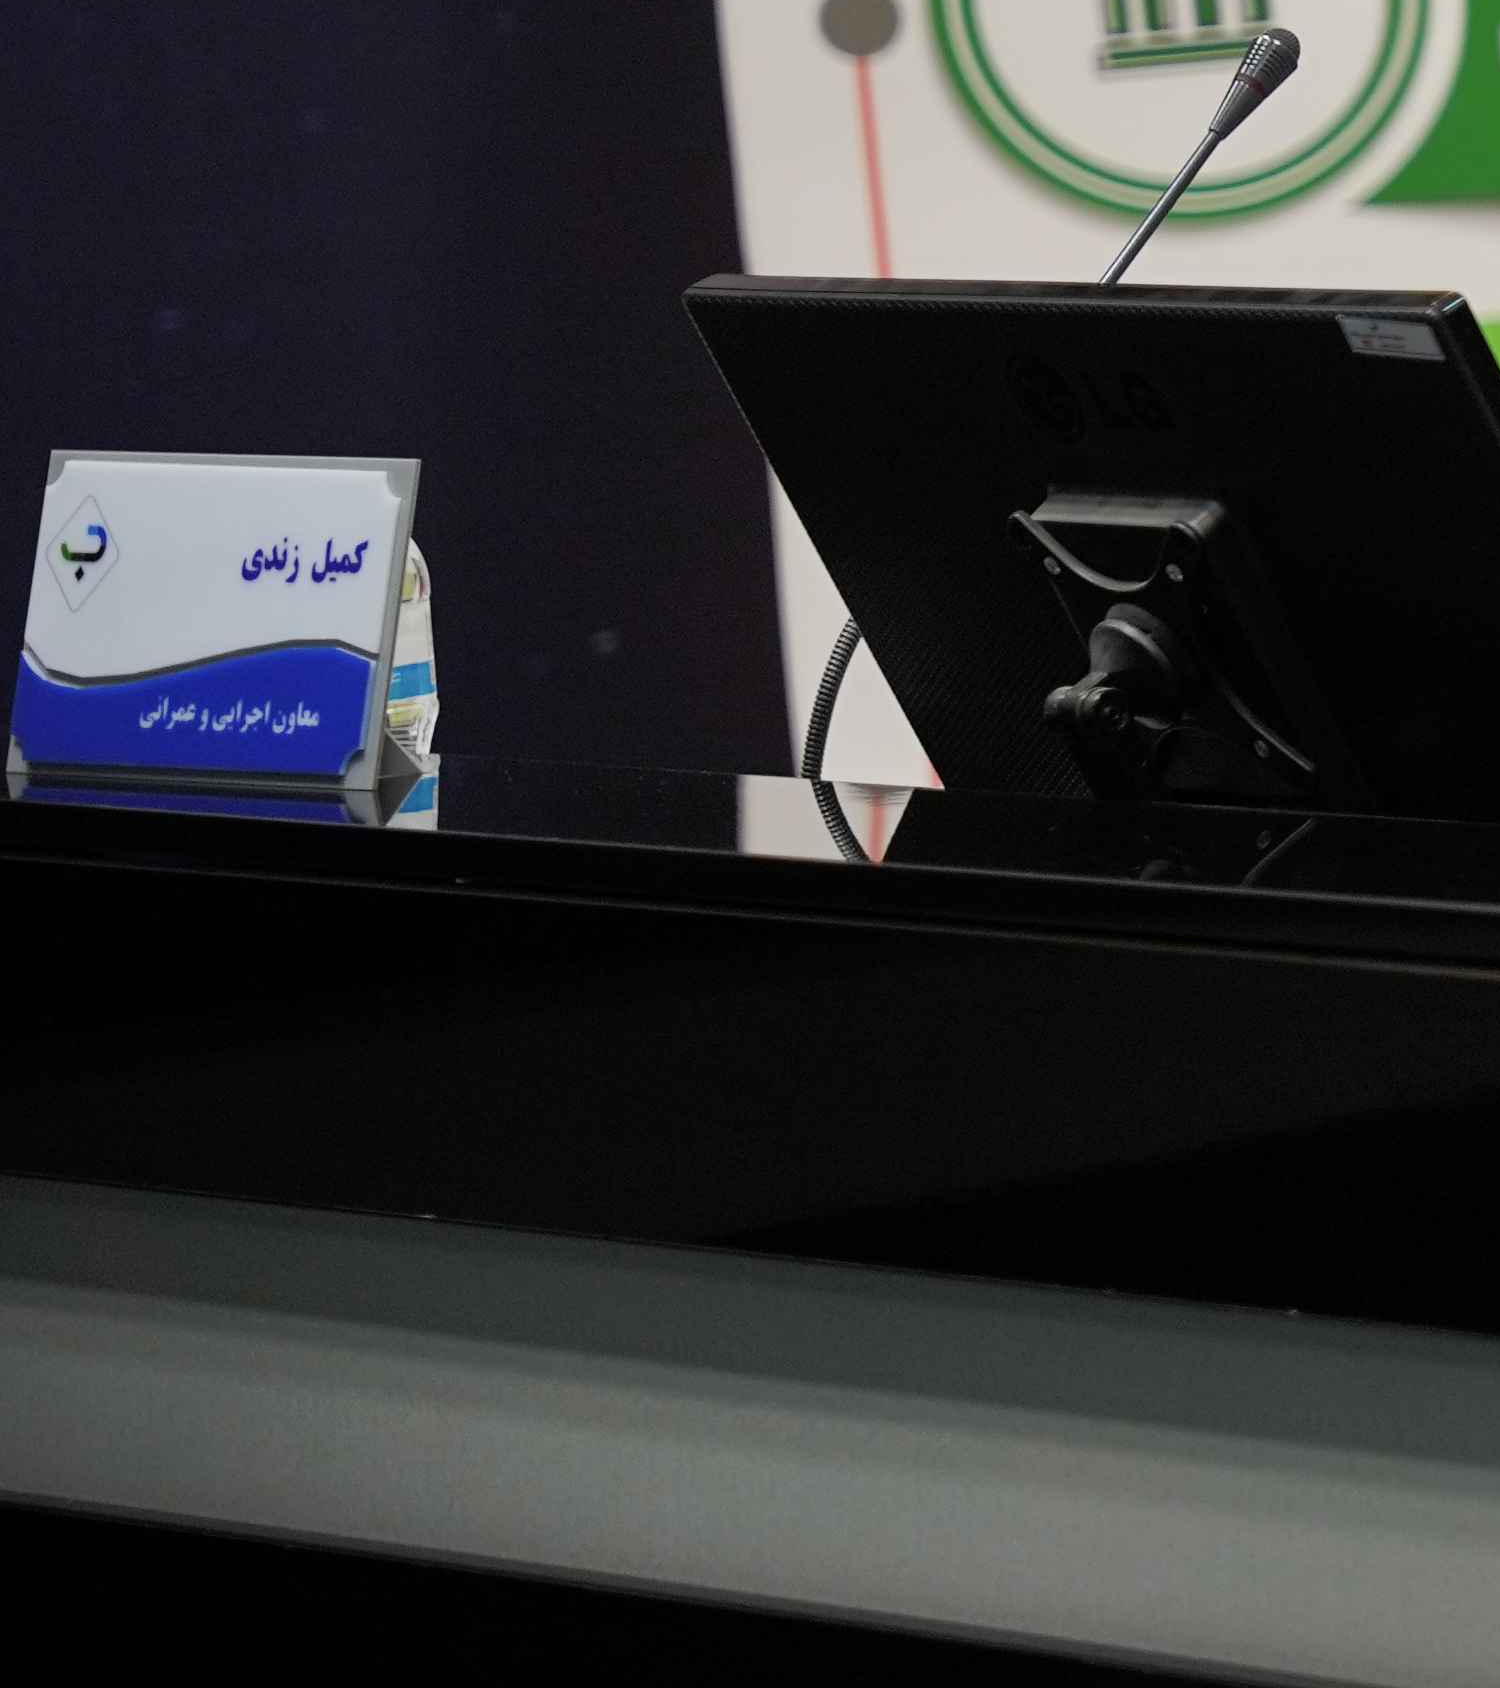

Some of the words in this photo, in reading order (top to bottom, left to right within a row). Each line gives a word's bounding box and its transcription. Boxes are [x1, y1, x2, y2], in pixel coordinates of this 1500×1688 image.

[1079, 368, 1176, 432] LG
[240, 537, 300, 584] زندی
[310, 537, 369, 584] کمیل
[139, 695, 197, 731] عمرانی
[198, 711, 210, 732] و
[211, 701, 271, 735] اجرایی
[272, 704, 320, 735] معاون
